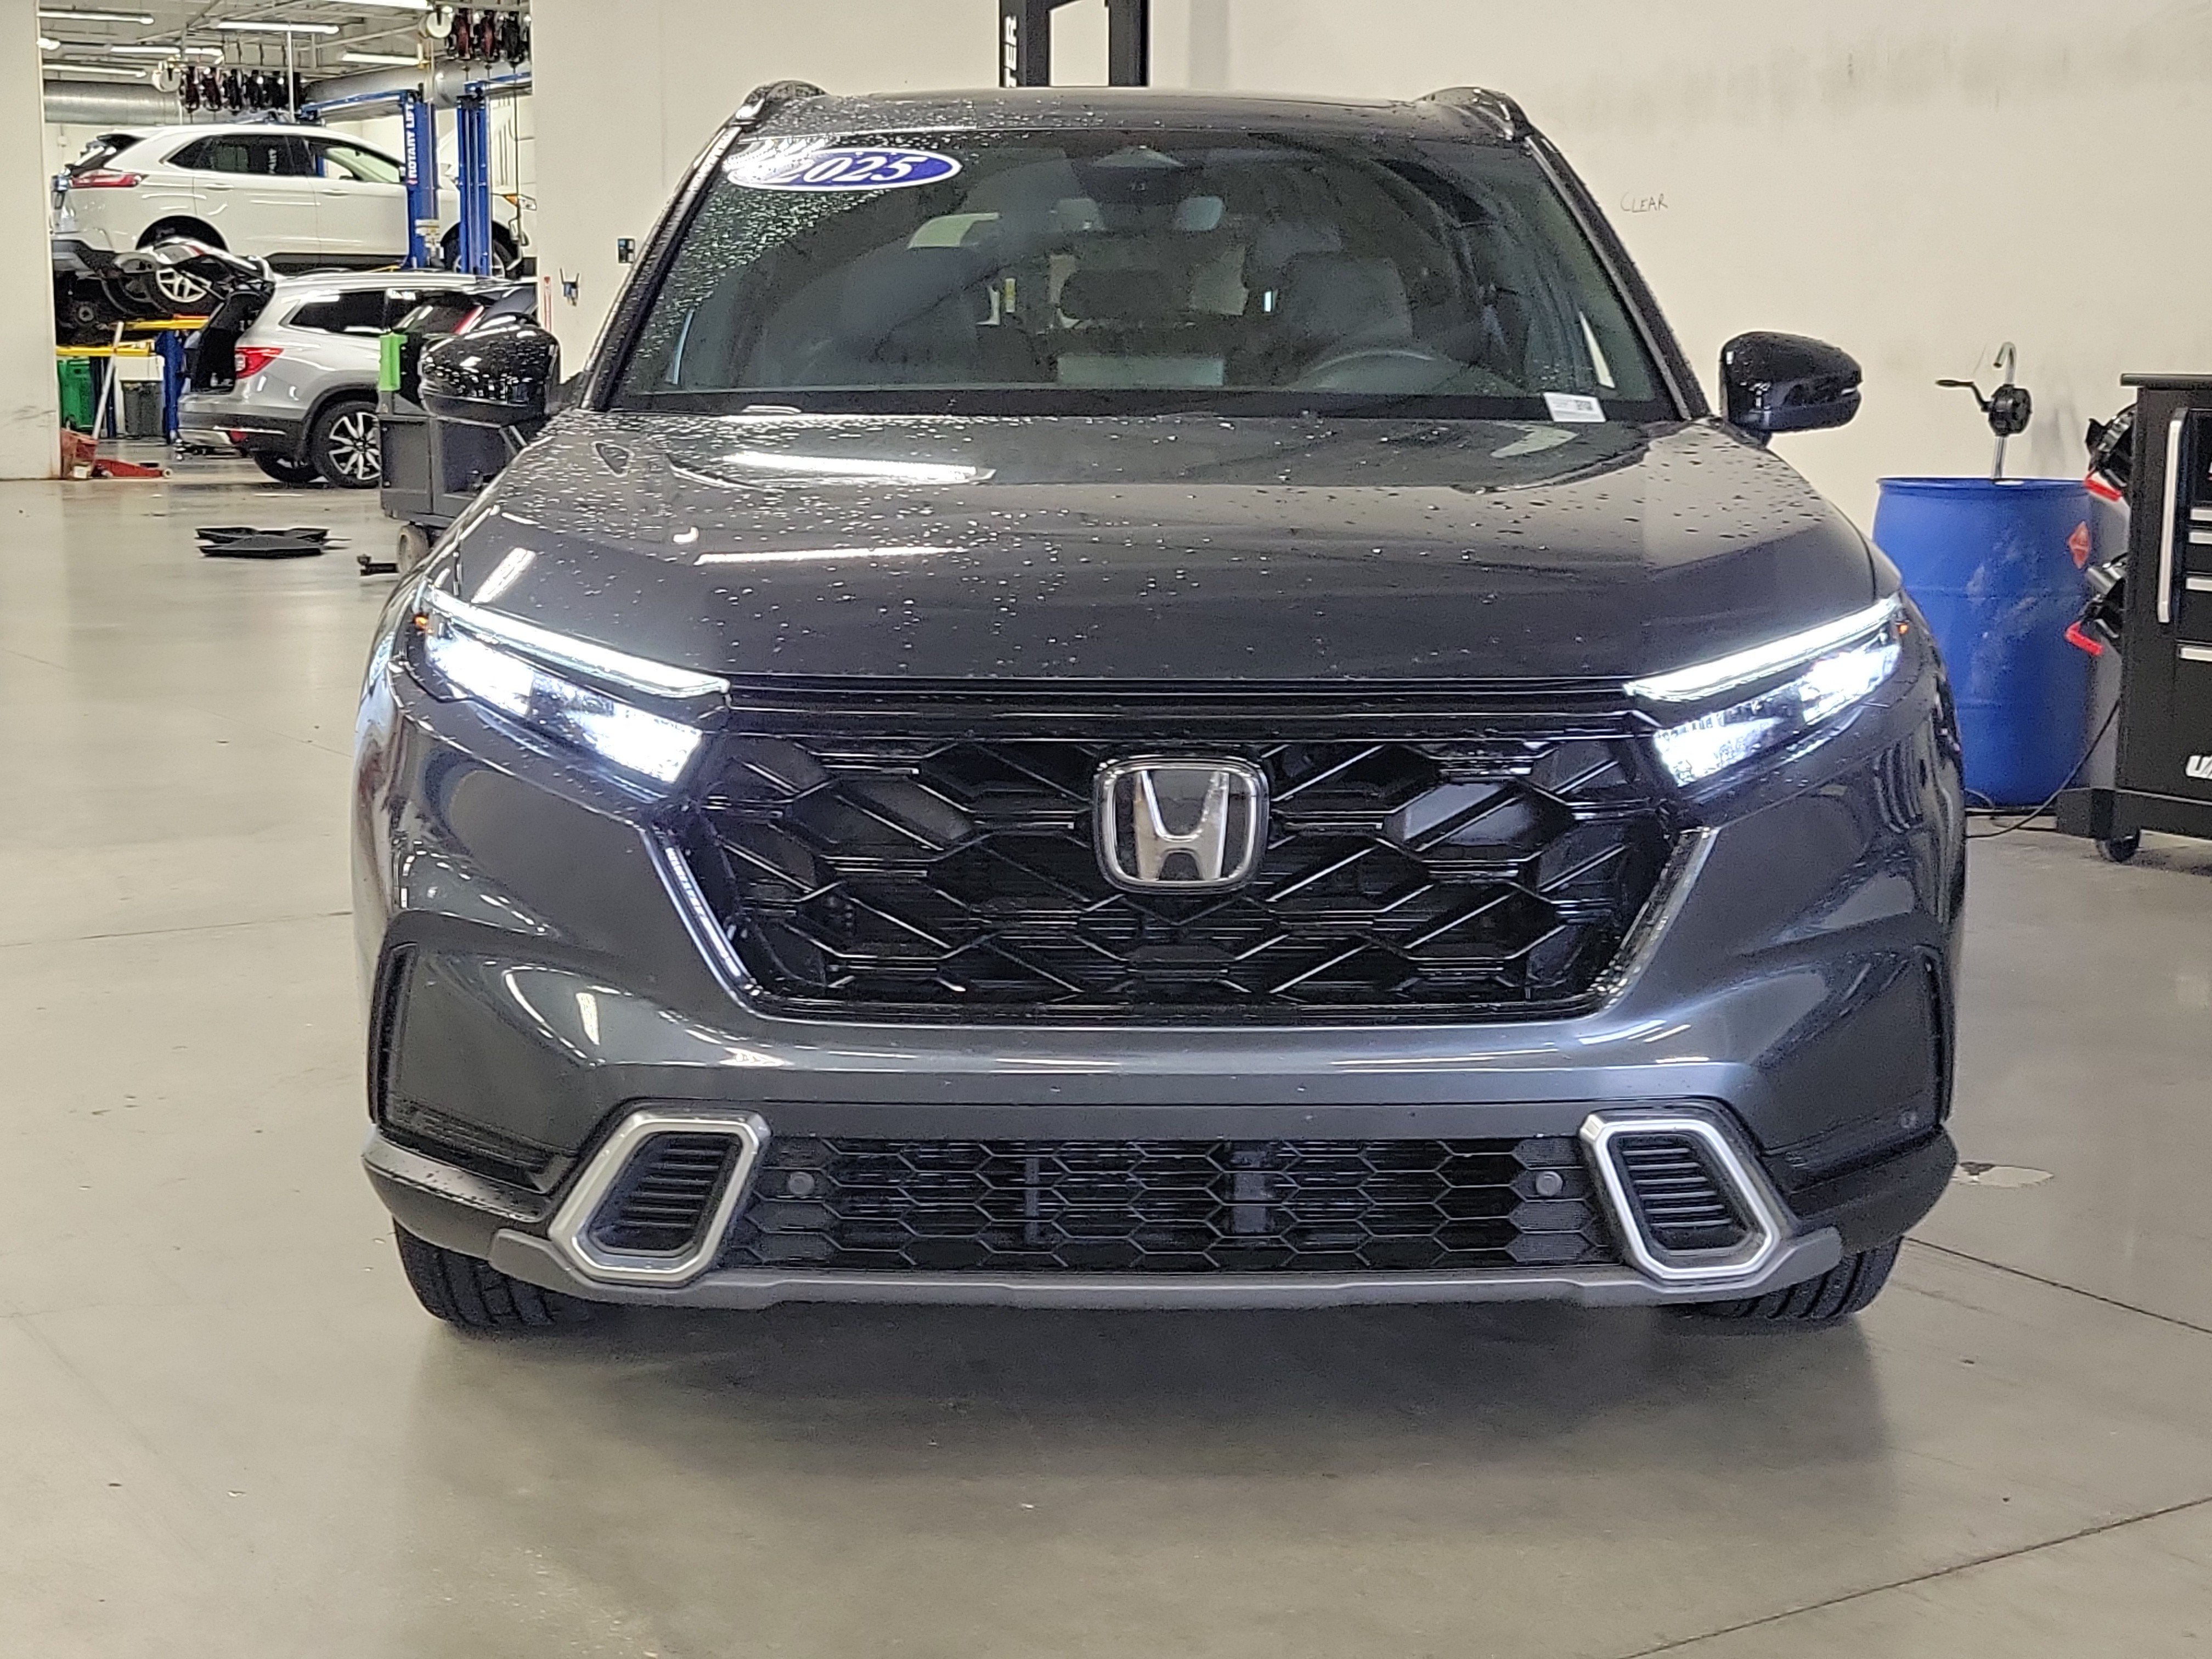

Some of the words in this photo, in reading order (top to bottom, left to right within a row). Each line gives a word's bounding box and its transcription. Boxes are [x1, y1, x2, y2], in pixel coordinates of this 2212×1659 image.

[405, 103, 415, 128] LIFT
[407, 131, 417, 178] ROTARY
[1620, 191, 1668, 213] CLEAR
